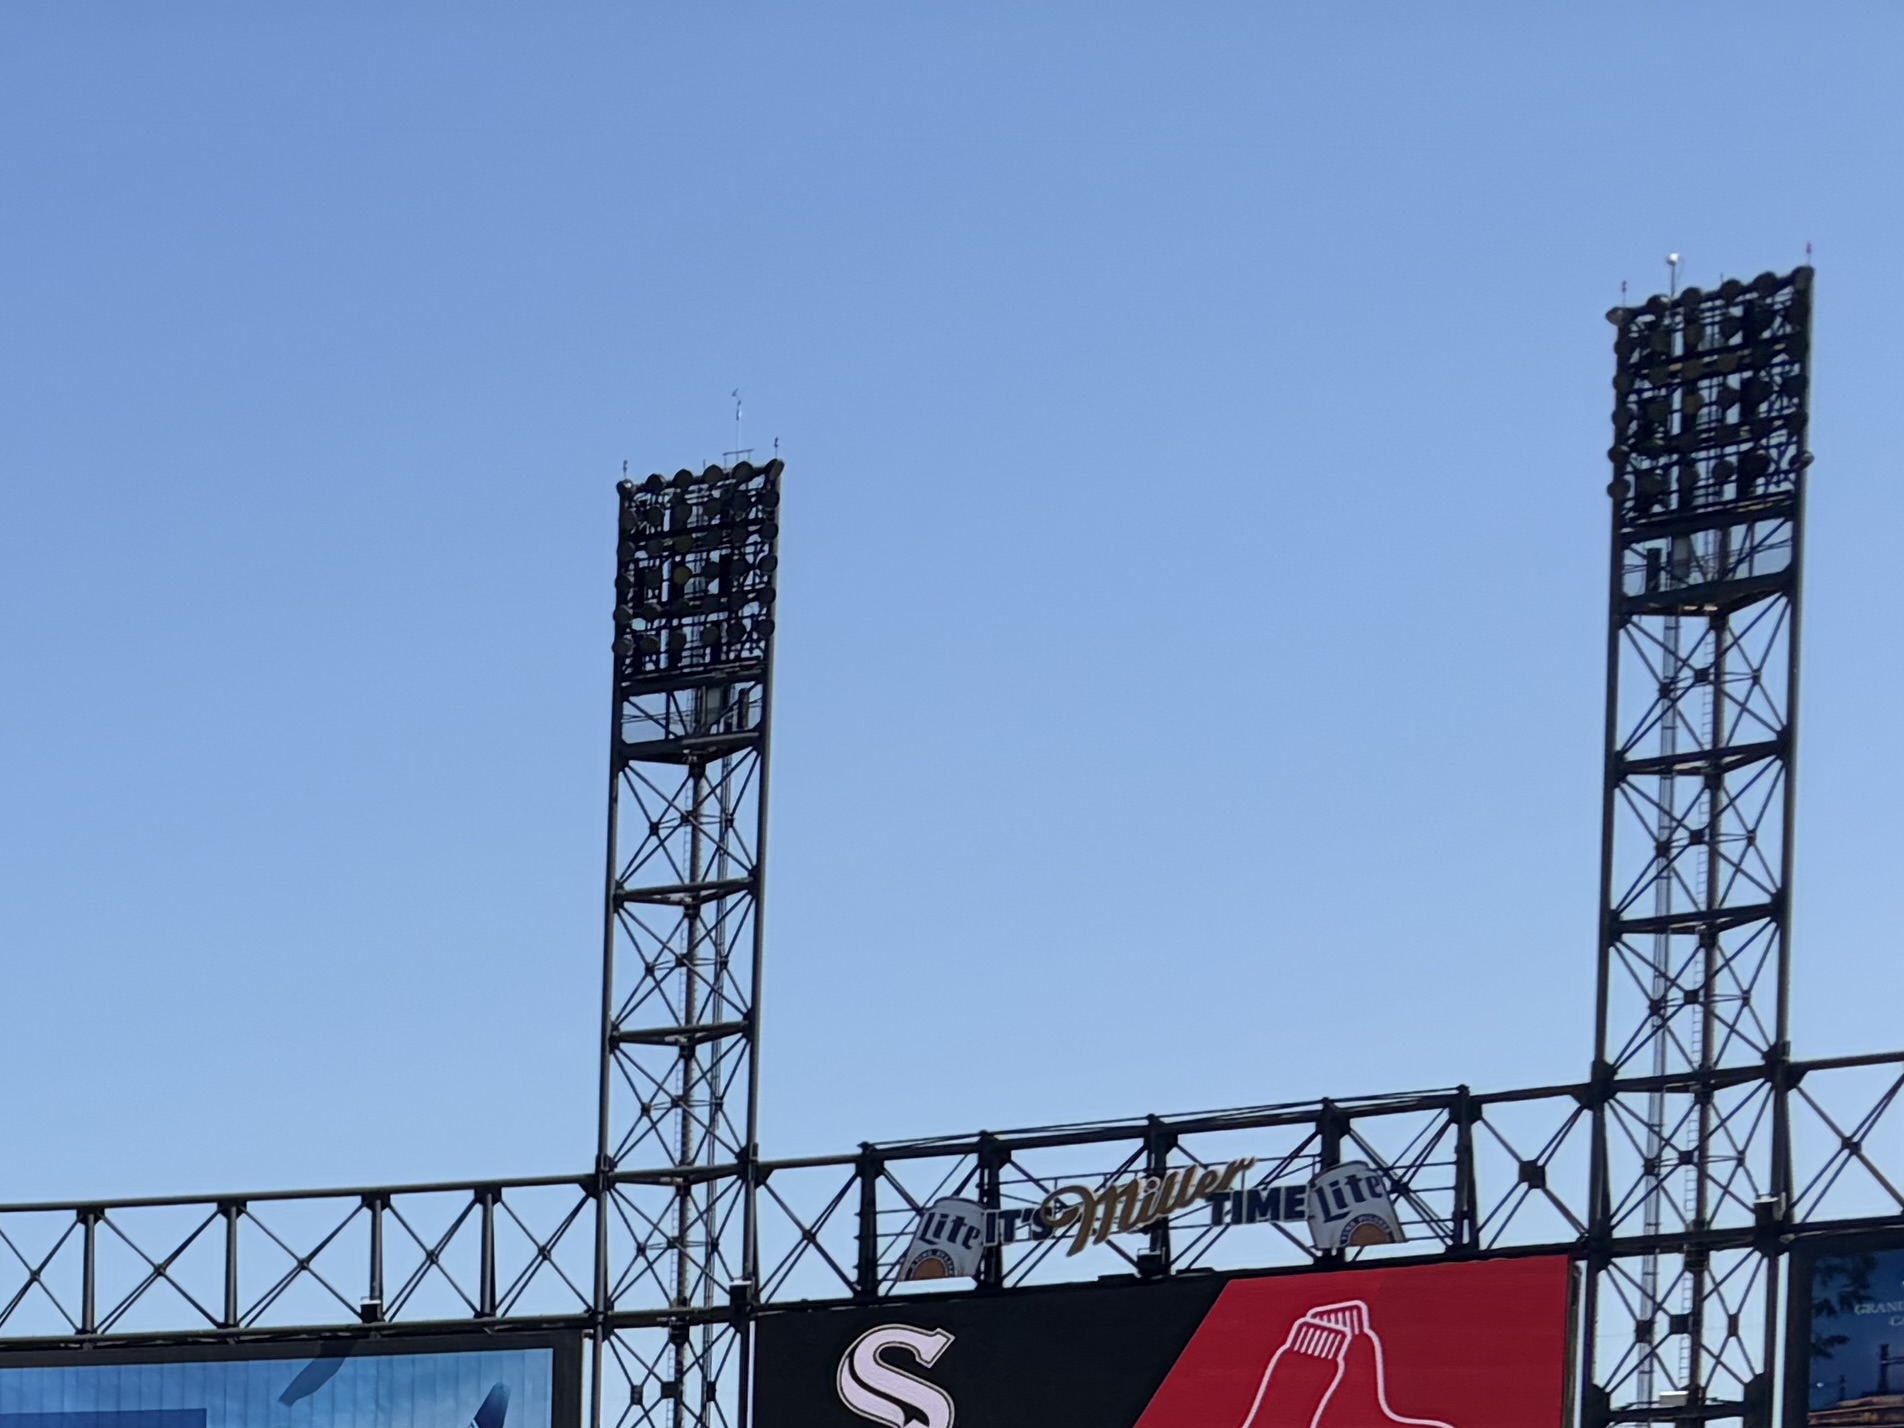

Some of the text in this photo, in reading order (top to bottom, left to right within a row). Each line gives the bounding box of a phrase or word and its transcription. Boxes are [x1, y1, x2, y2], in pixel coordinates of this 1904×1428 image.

[1042, 1158, 1257, 1257] Miller
[1206, 1186, 1308, 1227] TIME
[1315, 1174, 1383, 1223] Lite
[918, 1212, 982, 1250] Lite
